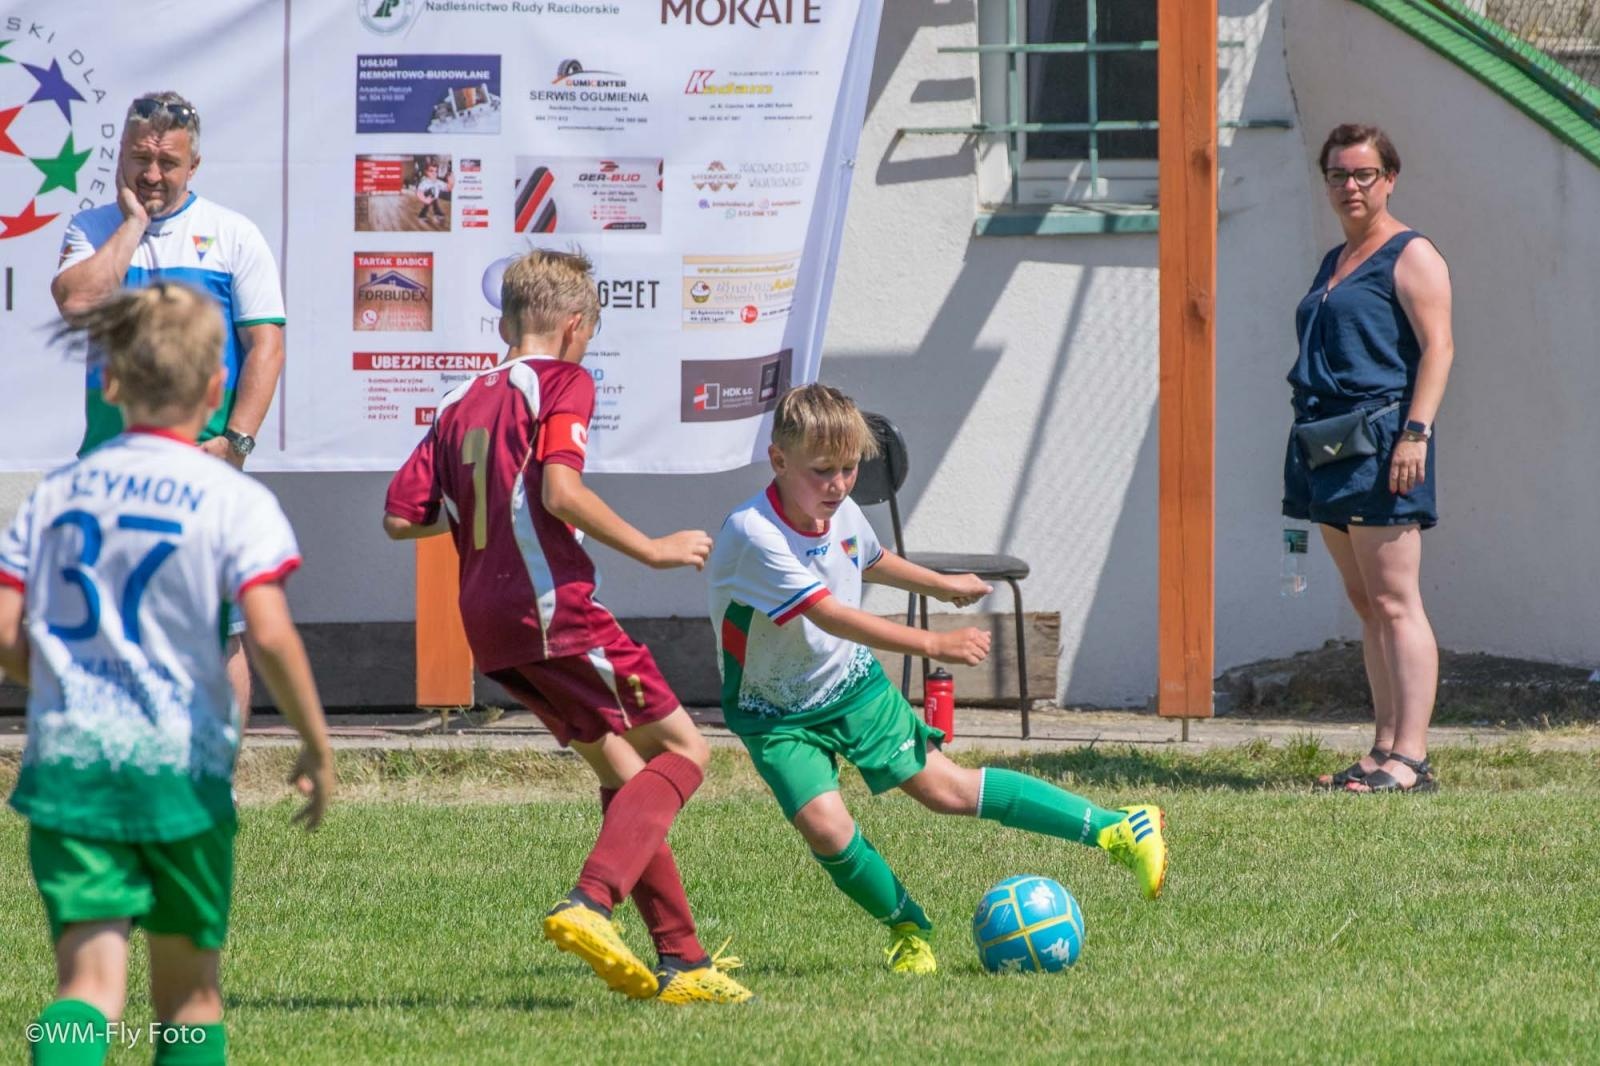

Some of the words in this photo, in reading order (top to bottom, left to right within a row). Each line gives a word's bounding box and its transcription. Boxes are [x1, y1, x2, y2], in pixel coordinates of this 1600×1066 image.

[426, 1, 508, 13] Nadleśnictwo
[512, 2, 543, 15] Rudy
[548, 3, 620, 15] Raciborskie
[660, 0, 821, 28] MOKATE
[360, 58, 398, 68] USŁUGI
[67, 48, 107, 104] DLA
[359, 70, 491, 80] REMONTOWO-BUDOWLANE
[529, 91, 577, 101] SERWIS
[579, 92, 649, 102] OGUMIENIA
[578, 173, 641, 182] GER-BUD
[358, 257, 393, 266] TARTAK
[396, 257, 429, 266] BABICE
[358, 289, 429, 302] FORBUDEX
[598, 280, 660, 308] GMET
[371, 356, 495, 369] UBEZPIECZENIA
[368, 377, 423, 385] komunikacyjne
[595, 384, 626, 395] rint
[462, 427, 490, 550] 1
[48, 508, 183, 645] 37
